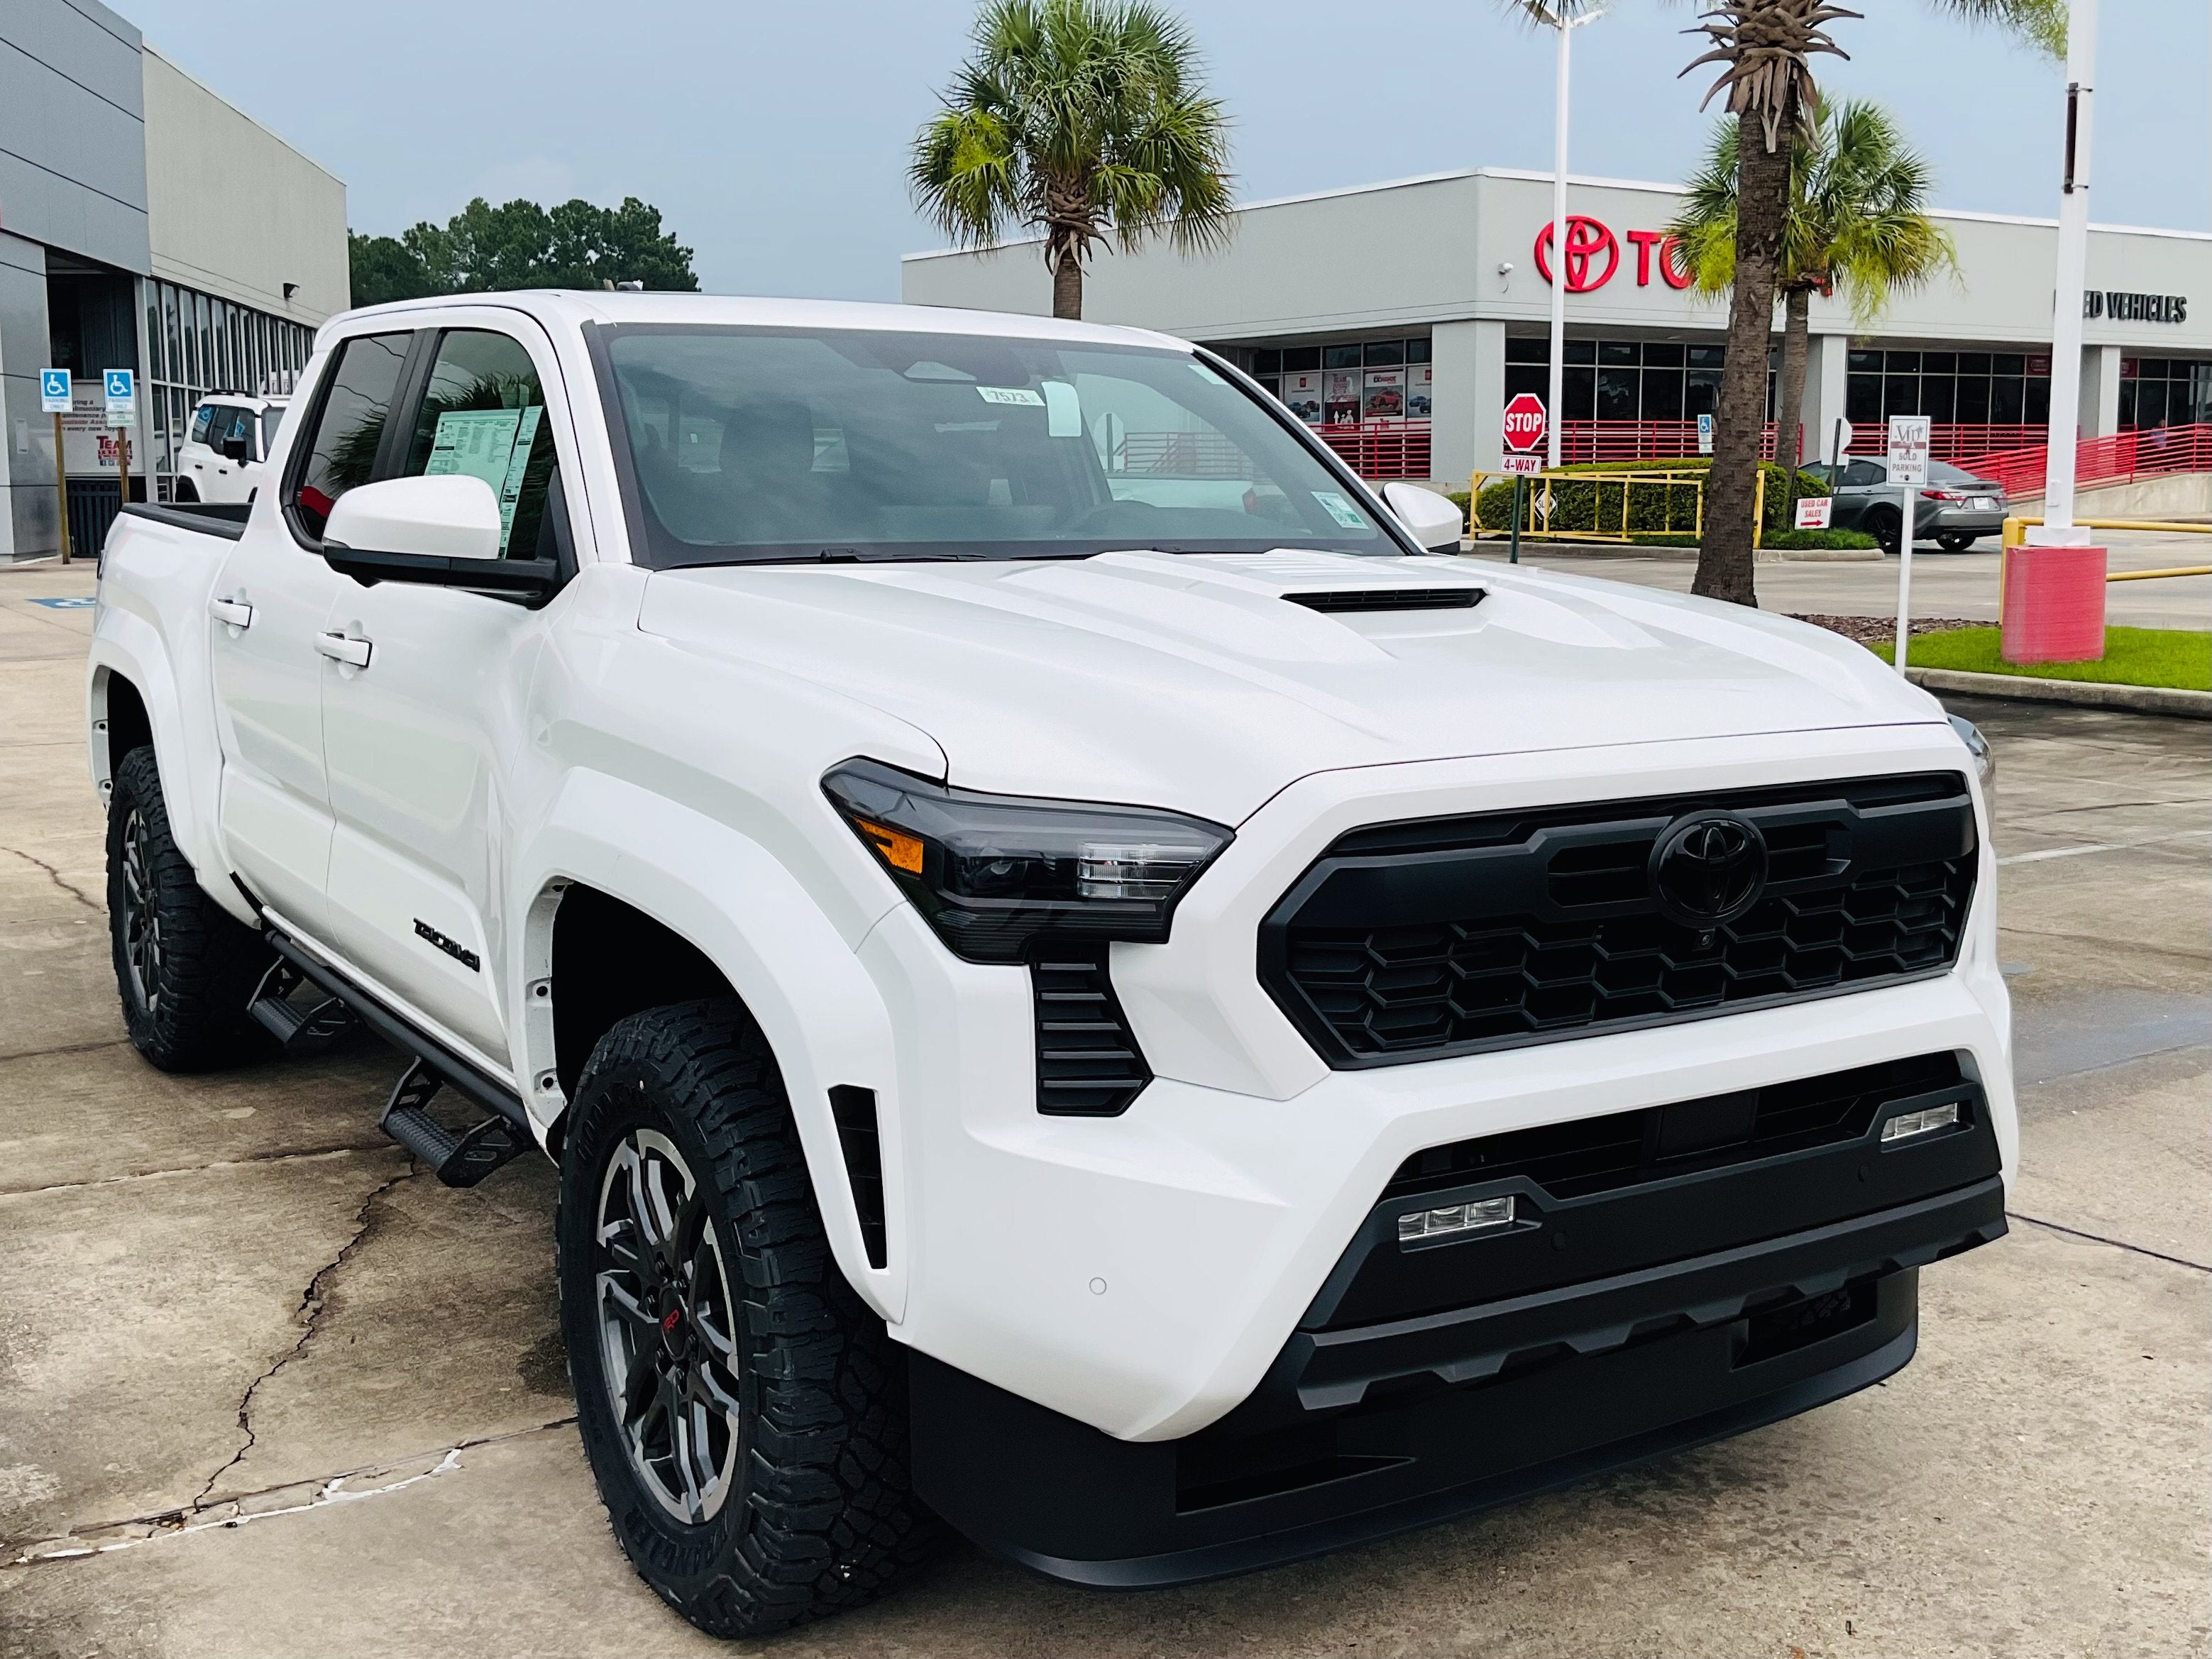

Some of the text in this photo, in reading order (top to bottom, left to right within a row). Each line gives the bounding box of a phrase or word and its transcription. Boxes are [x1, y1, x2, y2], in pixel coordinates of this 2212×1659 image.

[2106, 292, 2187, 322] VEHICLES
[1505, 413, 1542, 432] STOP
[1898, 453, 1917, 461] SOLD
[1504, 458, 1537, 472] 4-WAY
[1892, 463, 1922, 473] PARKING
[1538, 500, 1553, 509] SLW
[1800, 500, 1815, 508] USED
[1805, 509, 1822, 518] SALES
[413, 917, 480, 973] TACOMA
